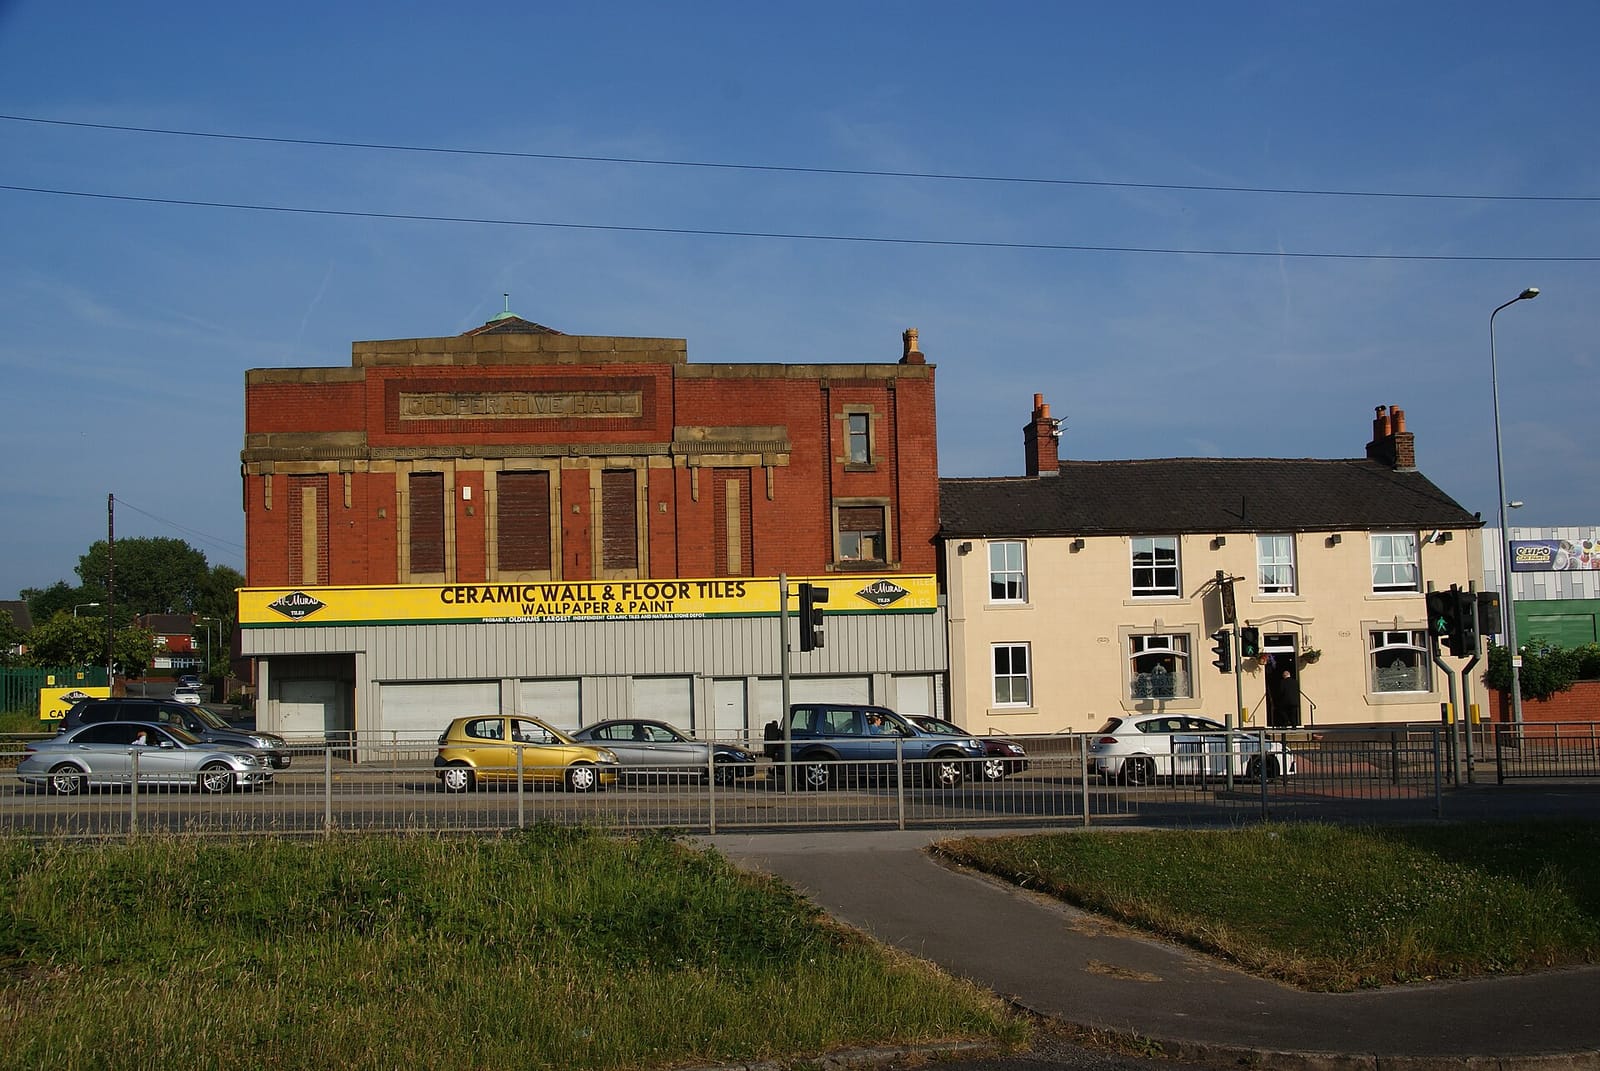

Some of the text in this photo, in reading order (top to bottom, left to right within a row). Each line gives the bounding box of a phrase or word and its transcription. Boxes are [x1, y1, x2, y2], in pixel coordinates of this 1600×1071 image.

[408, 396, 635, 415] CO-OPERATIVE HALL
[440, 581, 746, 604] CERAMIC WALL & FLOOR TILES
[522, 601, 674, 615] WALLPAPER & PAINT
